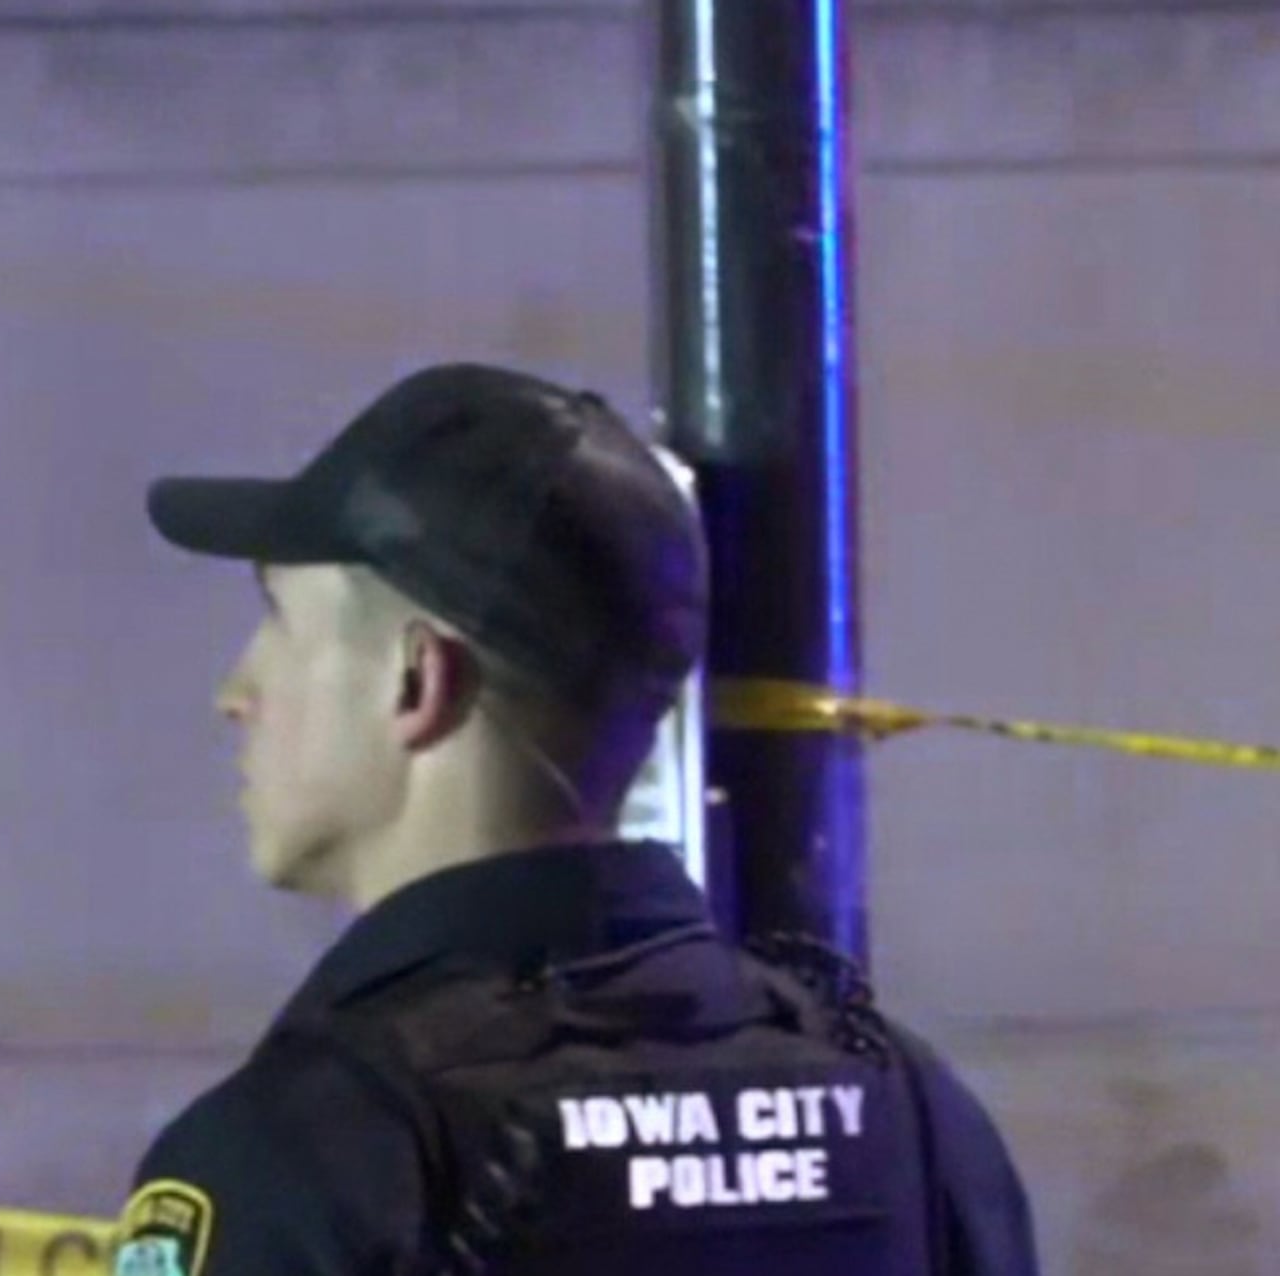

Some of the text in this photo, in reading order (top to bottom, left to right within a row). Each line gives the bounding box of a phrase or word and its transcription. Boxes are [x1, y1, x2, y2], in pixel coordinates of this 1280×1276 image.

[559, 1086, 864, 1149] IOWA CITY
[630, 1150, 829, 1209] POLICE
